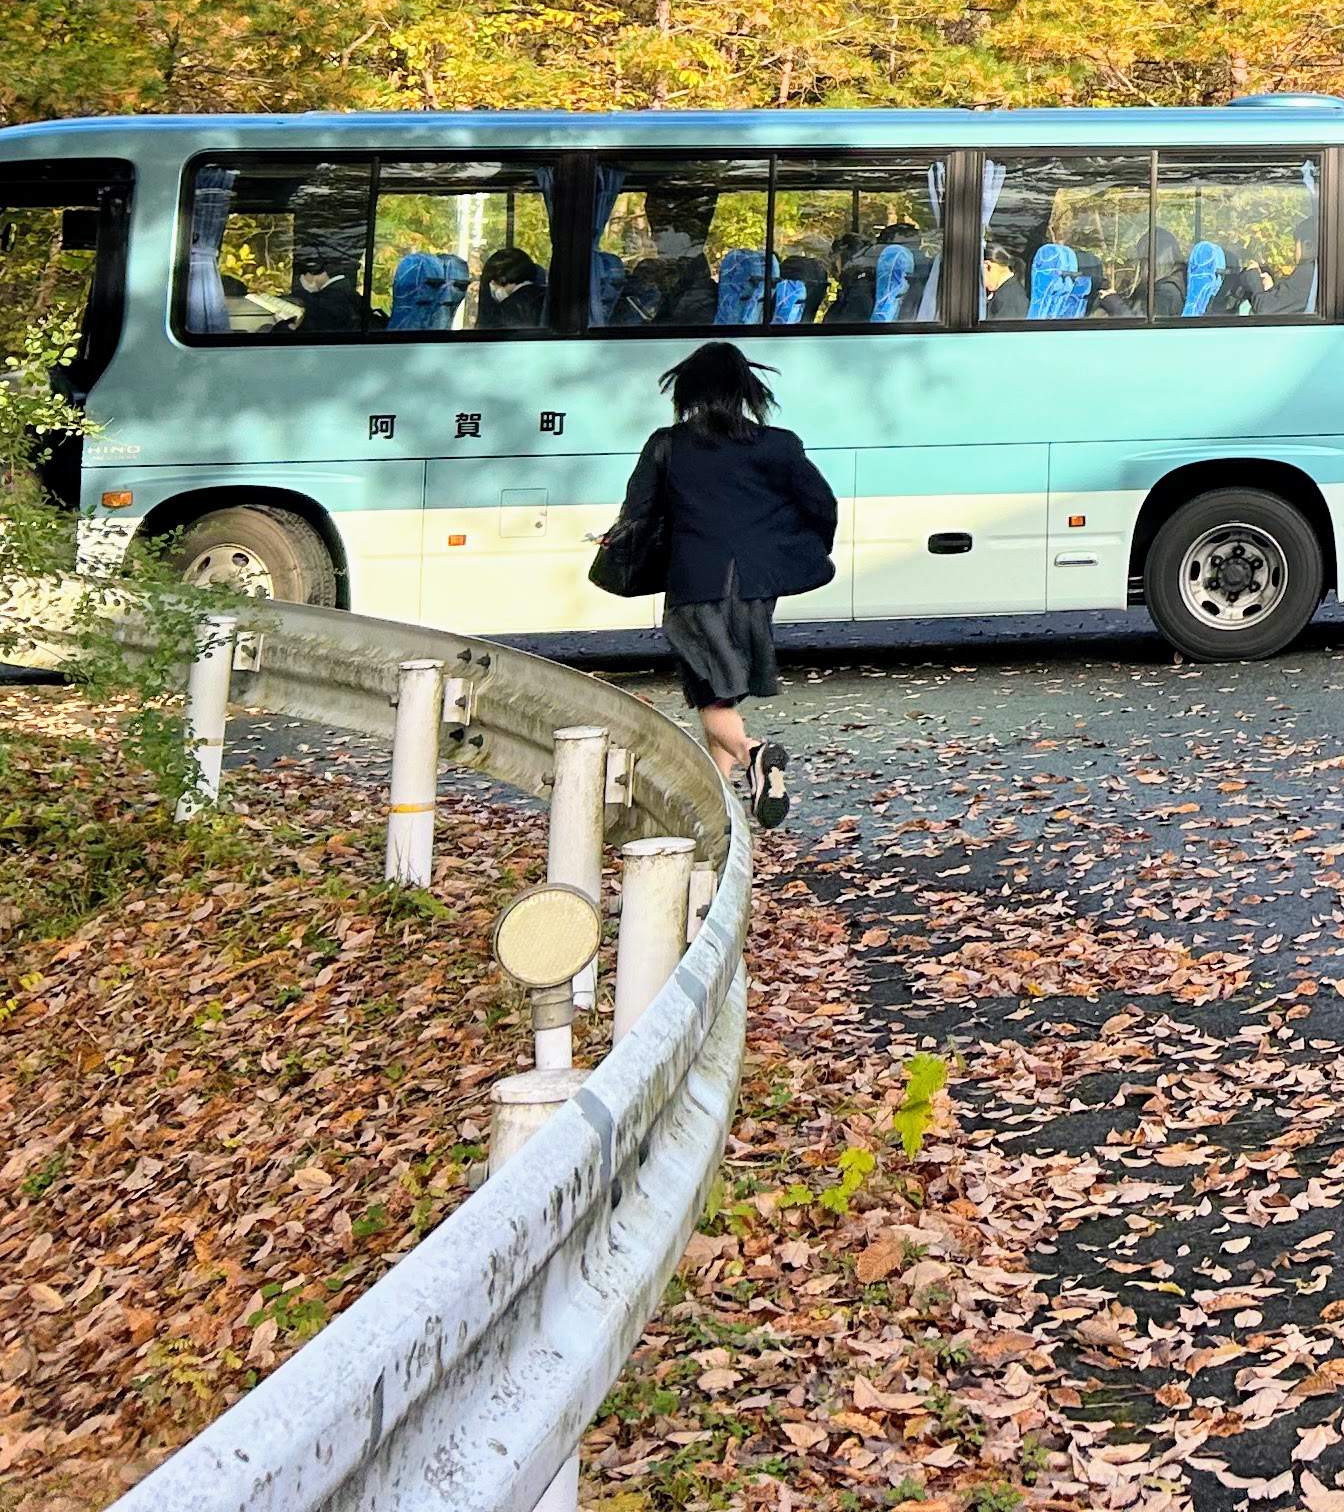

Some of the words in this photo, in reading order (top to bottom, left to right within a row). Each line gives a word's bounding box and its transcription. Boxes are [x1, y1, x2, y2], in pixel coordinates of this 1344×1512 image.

[368, 411, 566, 440] 阿賀町
[87, 445, 141, 454] HINO
